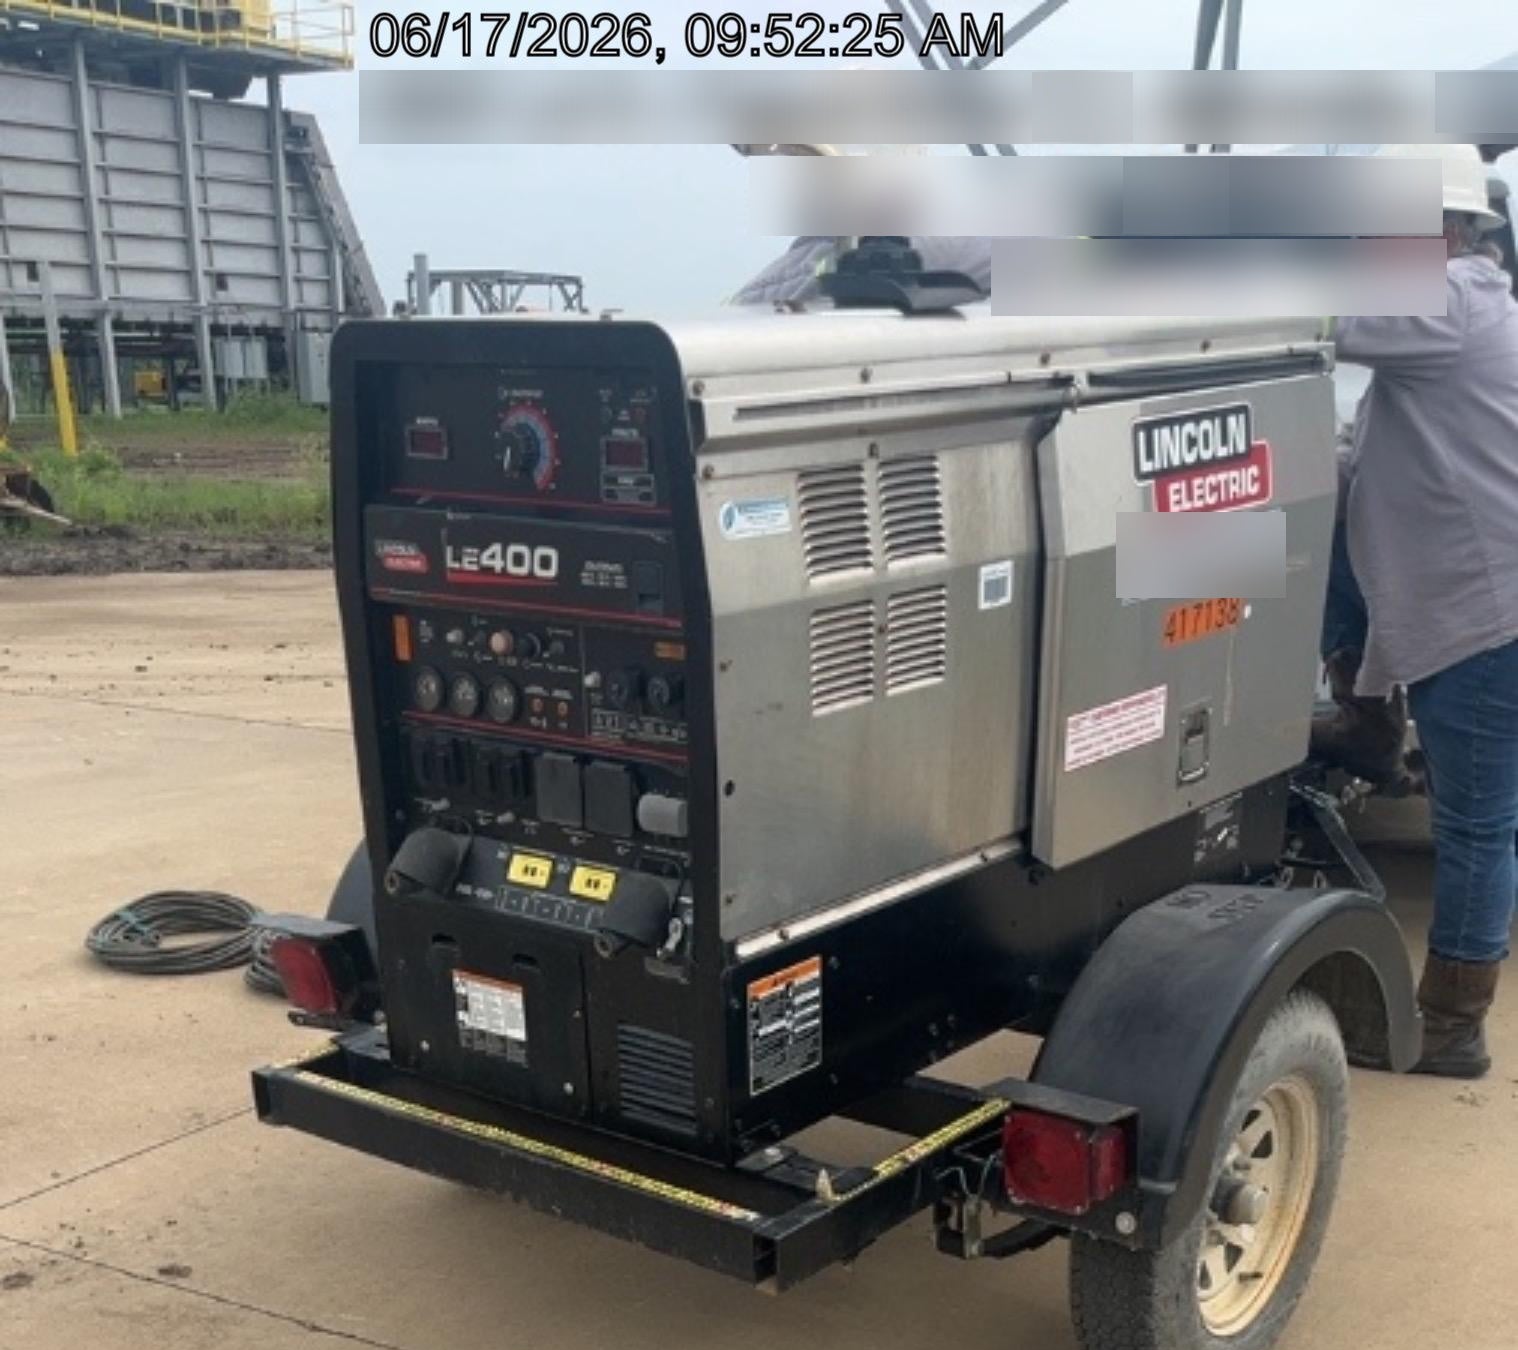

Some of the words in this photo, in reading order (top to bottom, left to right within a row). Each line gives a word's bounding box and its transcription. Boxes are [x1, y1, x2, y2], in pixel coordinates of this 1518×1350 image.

[1138, 414, 1246, 472] LINCOLN
[1168, 465, 1260, 512] ELECTRIC
[447, 542, 559, 577] LE400
